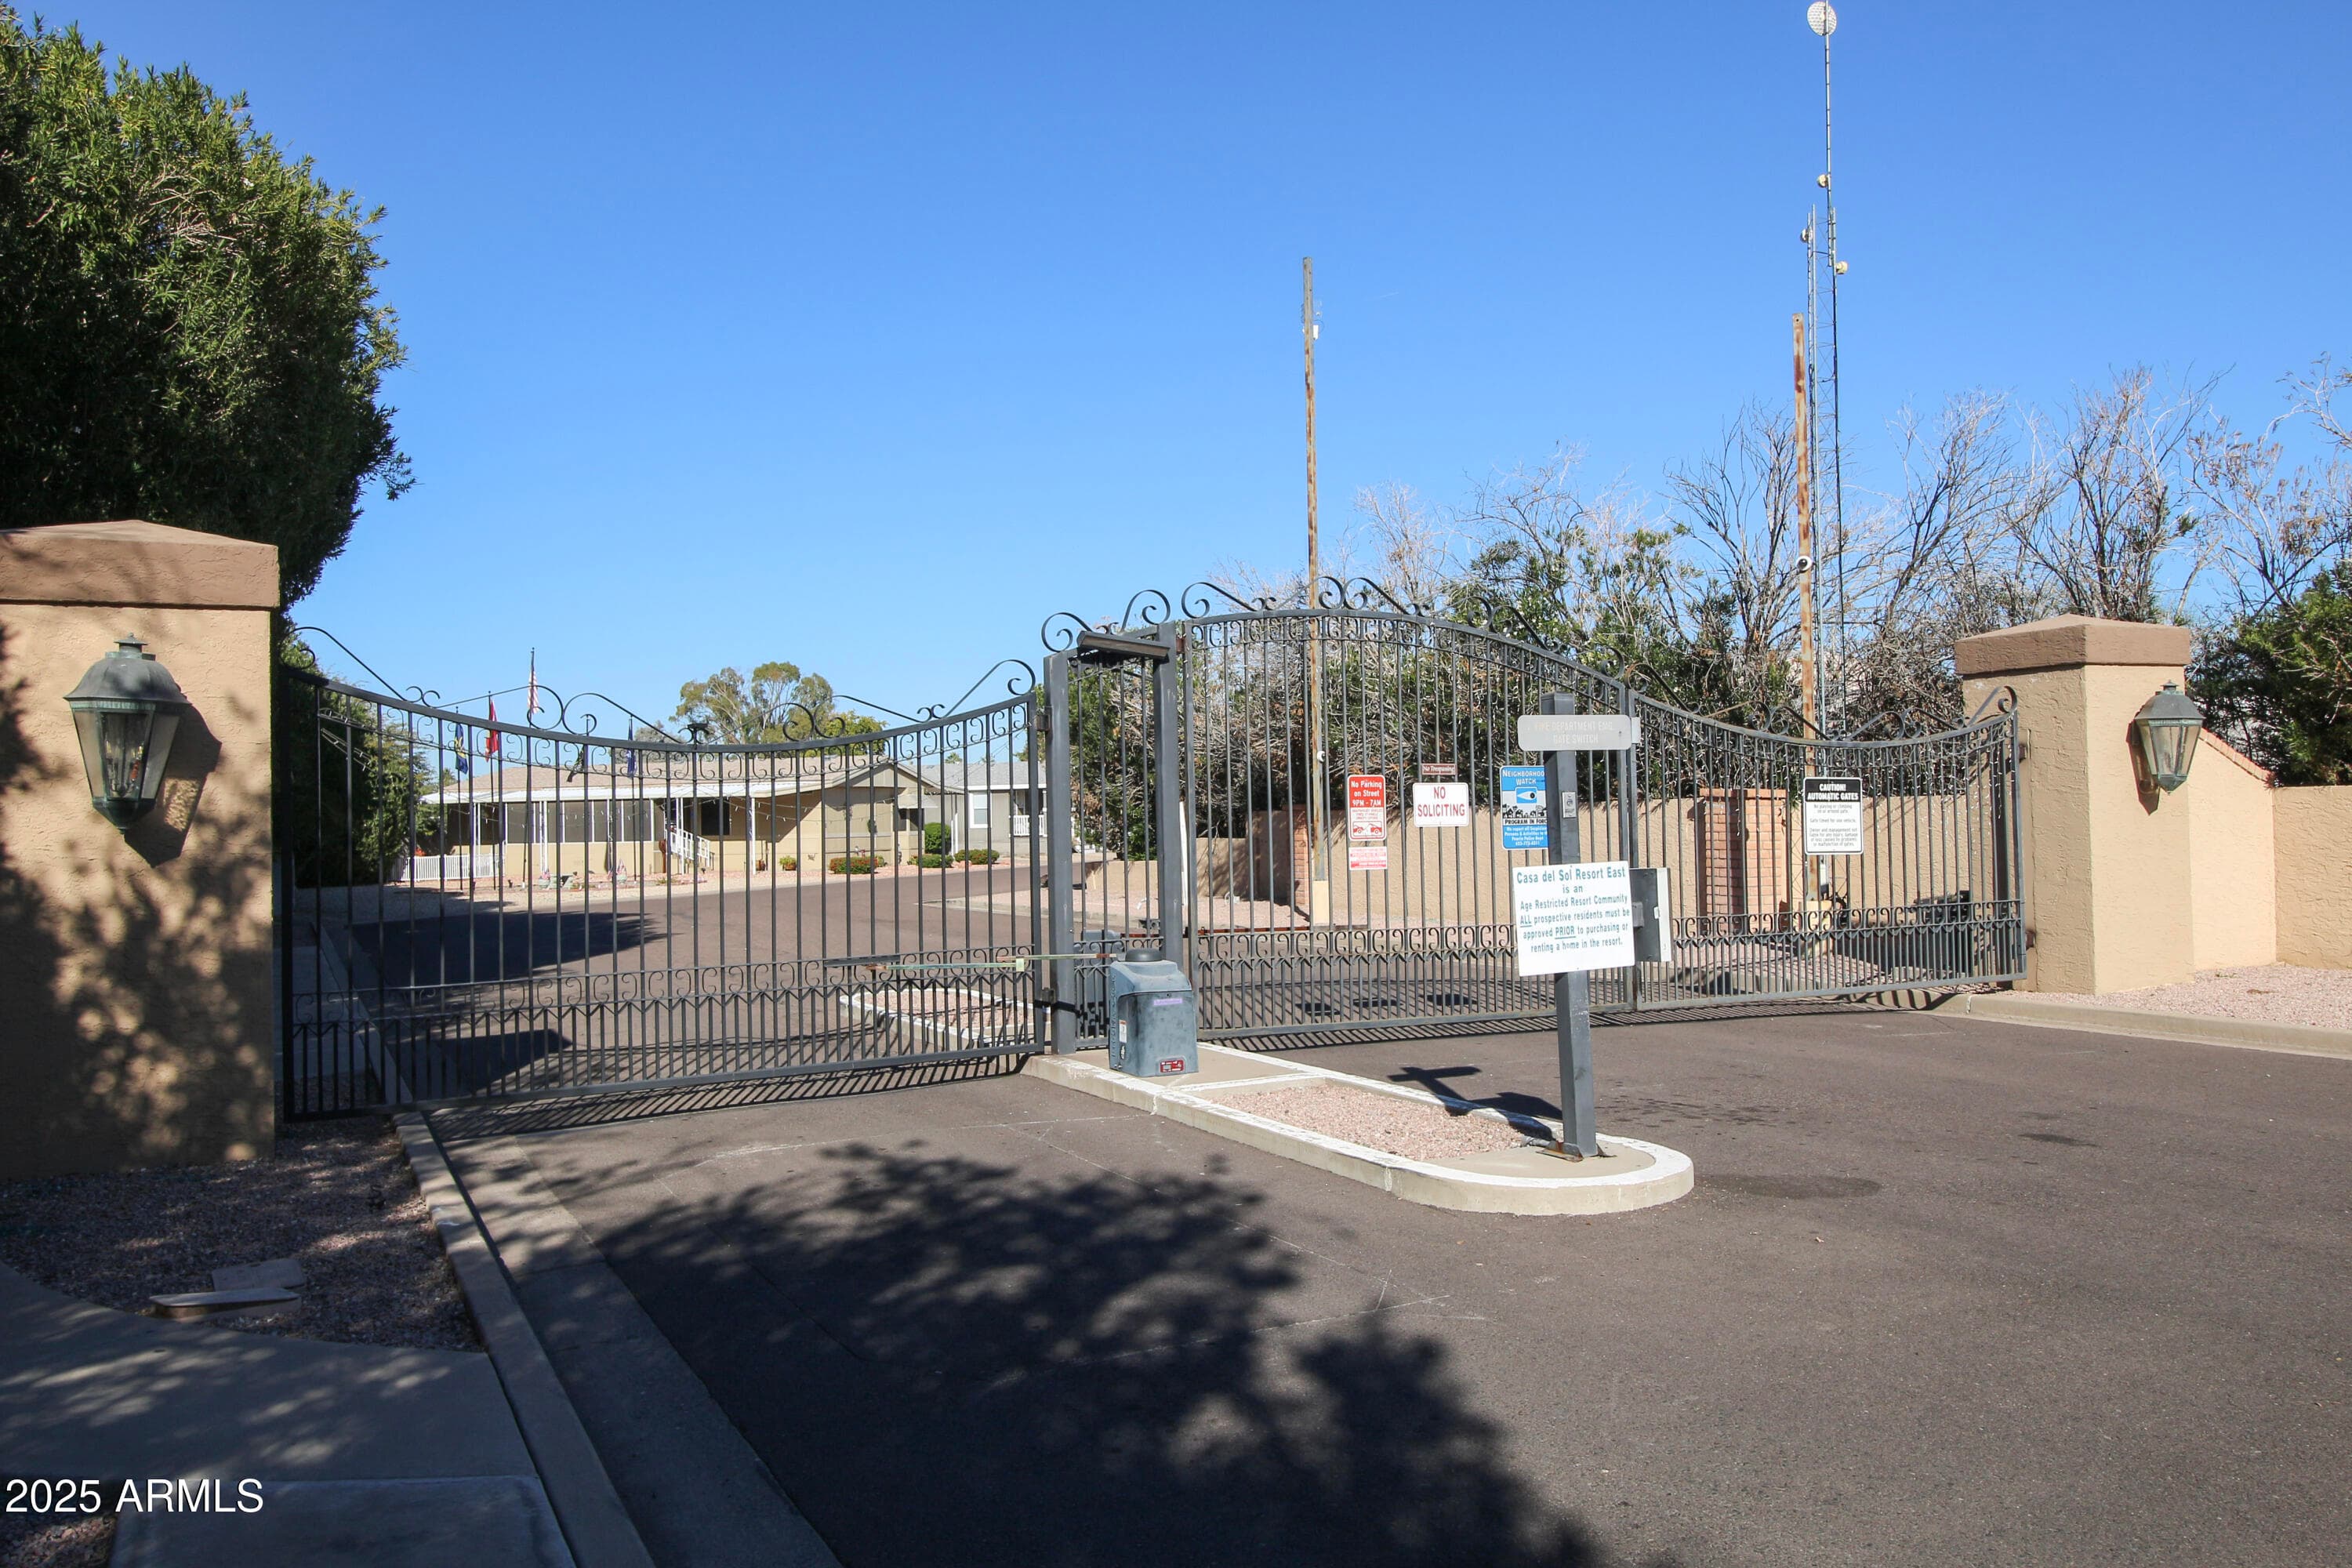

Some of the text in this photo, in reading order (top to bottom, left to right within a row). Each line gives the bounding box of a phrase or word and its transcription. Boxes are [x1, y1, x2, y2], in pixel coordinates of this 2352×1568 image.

[1552, 720, 1596, 730] DEPARTMENT
[1572, 734, 1599, 744] SWITCH
[1361, 779, 1382, 789] Parking
[1819, 783, 1847, 792] CAUTION!
[1433, 786, 1446, 800] NO
[1807, 792, 1859, 800] AUTOMATIC GATES
[1417, 803, 1465, 817] SOLICITING
[1517, 866, 1625, 884] Casa del Sol Resort East
[1562, 884, 1584, 894] is an
[1520, 894, 1628, 912] Age Restricted Resort Community
[1520, 907, 1631, 925] ALL prospective residents must be
[1523, 928, 1553, 941] approved
[1555, 925, 1575, 936] PRIOR
[1577, 925, 1584, 935] to
[1586, 923, 1620, 935] purchasing
[1530, 942, 1554, 953] renting
[1562, 940, 1580, 950] home
[1581, 939, 1588, 949] in
[1589, 938, 1600, 948] the
[1602, 937, 1623, 947] resort.
